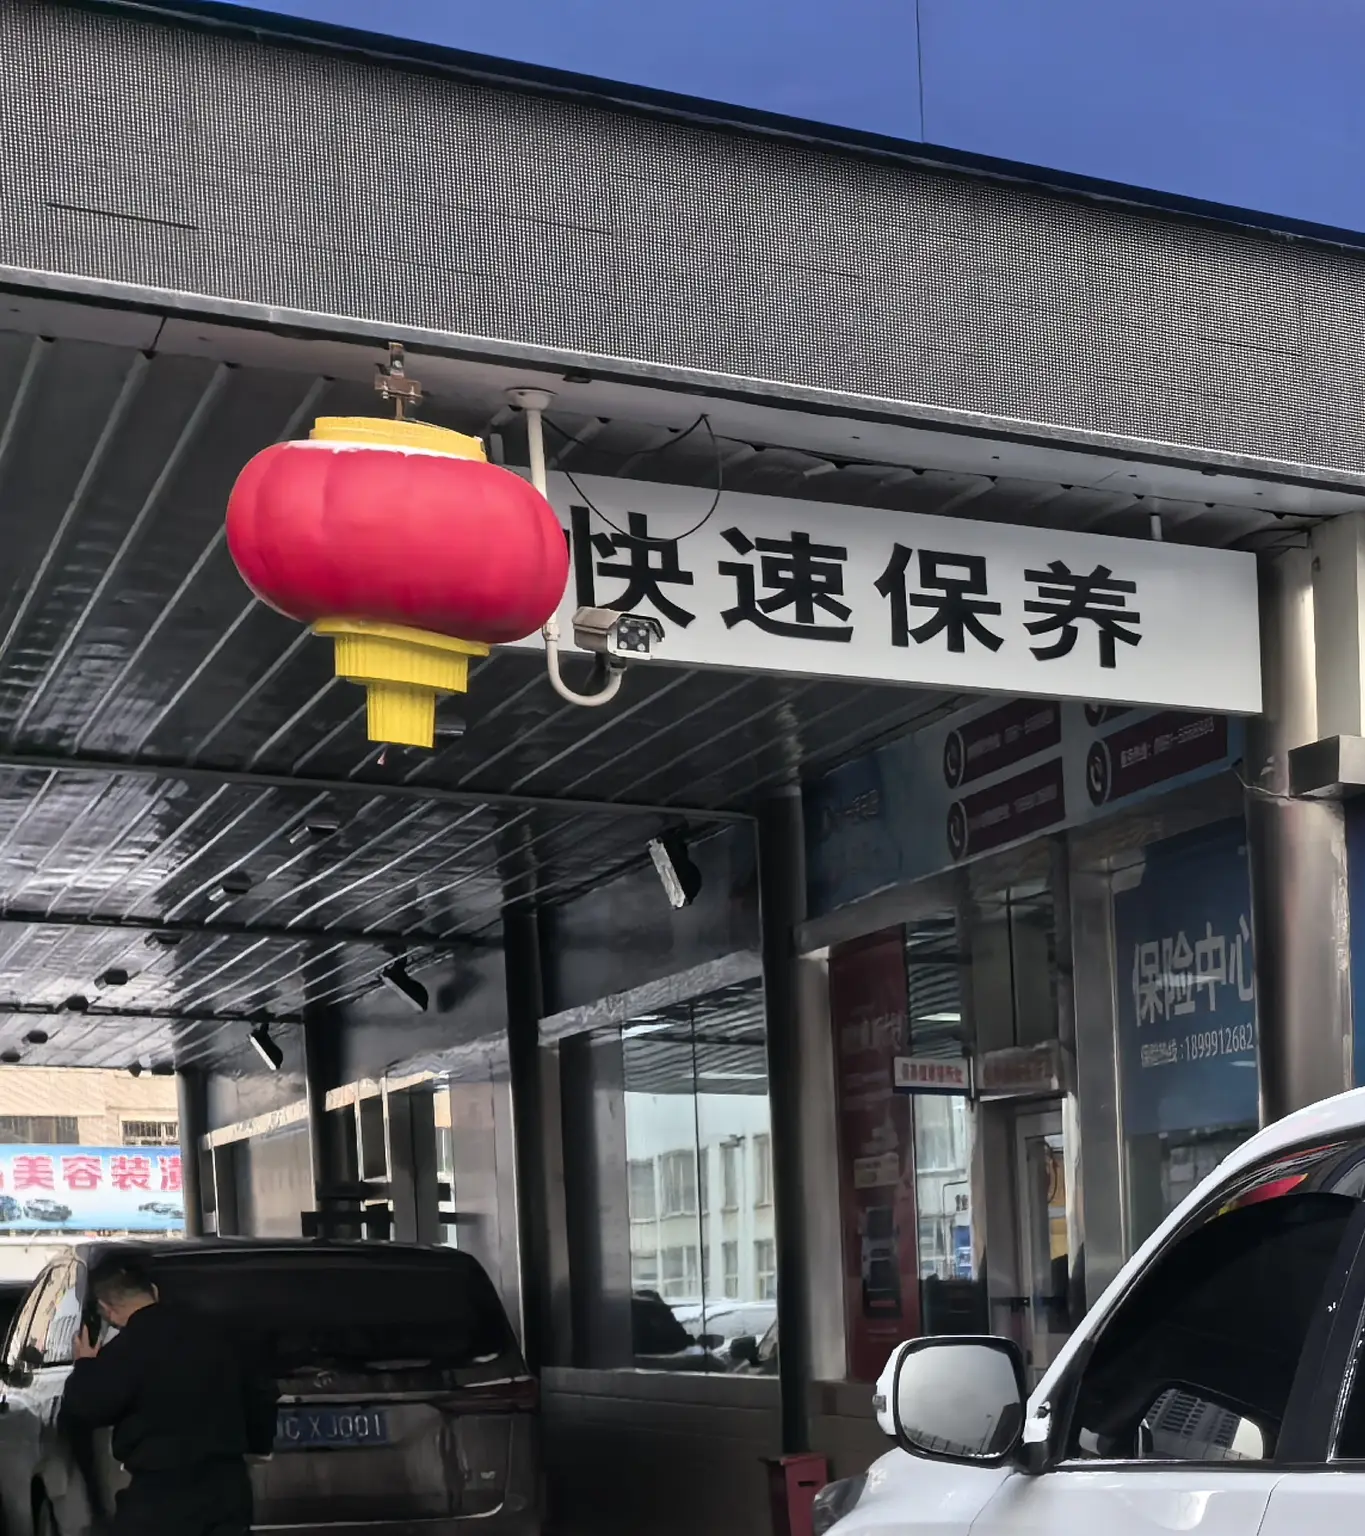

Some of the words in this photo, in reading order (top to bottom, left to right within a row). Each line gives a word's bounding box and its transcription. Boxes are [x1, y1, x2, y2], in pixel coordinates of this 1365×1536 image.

[562, 504, 1143, 670] 快速保养
[1133, 913, 1254, 1028] 保险中心
[0, 1155, 183, 1191] 美容装潢
